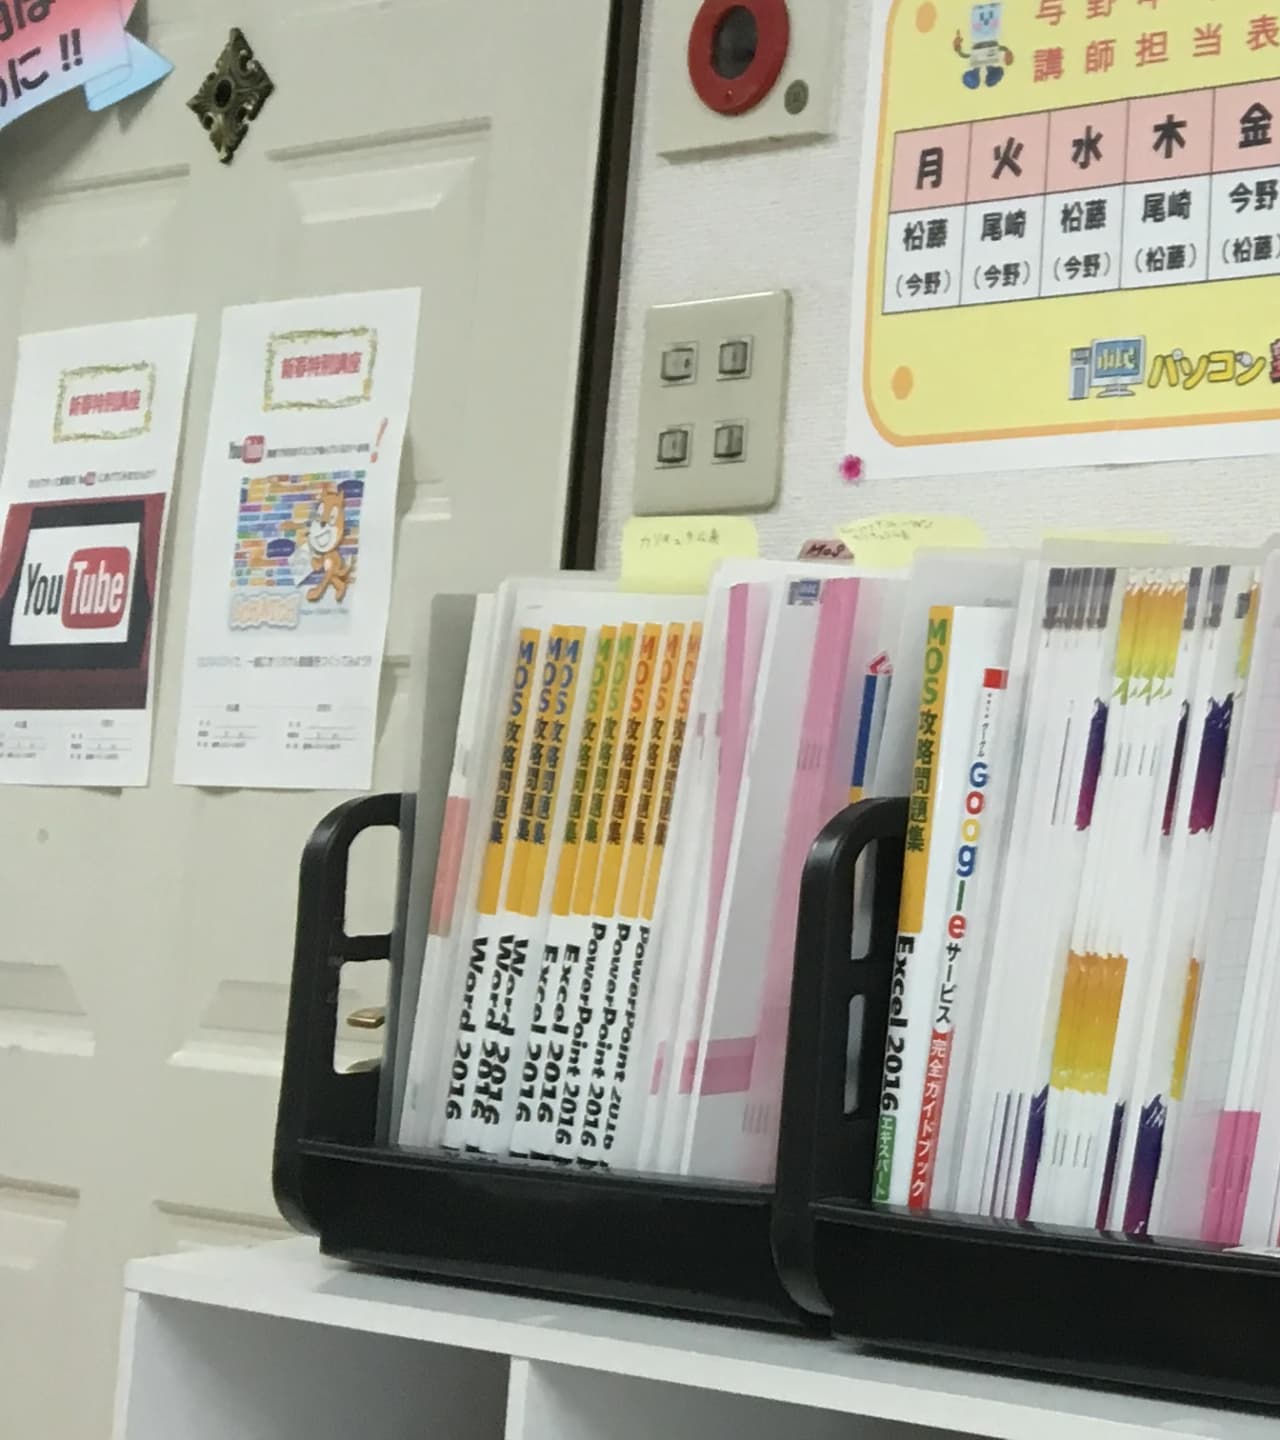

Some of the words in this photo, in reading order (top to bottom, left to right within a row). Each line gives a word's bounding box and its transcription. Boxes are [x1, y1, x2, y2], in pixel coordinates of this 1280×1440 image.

[1033, 14, 1280, 83] 講師担当表
[992, 136, 1025, 180] 火
[1071, 125, 1103, 170] 水
[1152, 114, 1188, 159] 木
[1238, 102, 1273, 150] 金
[916, 146, 944, 189] 月
[1228, 179, 1279, 214] 今野
[980, 211, 1027, 244] 尾崎
[1142, 190, 1192, 224] 尾崎
[23, 559, 126, 618] YouTube
[459, 936, 489, 1033] Word
[530, 944, 559, 1034] Excel
[551, 943, 581, 1034] Excel
[564, 922, 607, 1076] PowerPoint
[589, 922, 631, 1080] PowerPoint
[890, 935, 915, 1028] Excel
[445, 1041, 472, 1121] 2016
[515, 1043, 542, 1122] 2016
[537, 1040, 564, 1123] 2016
[880, 1035, 905, 1115] 2016
[555, 1080, 581, 1145] 2016
[580, 1086, 606, 1148] 2016
